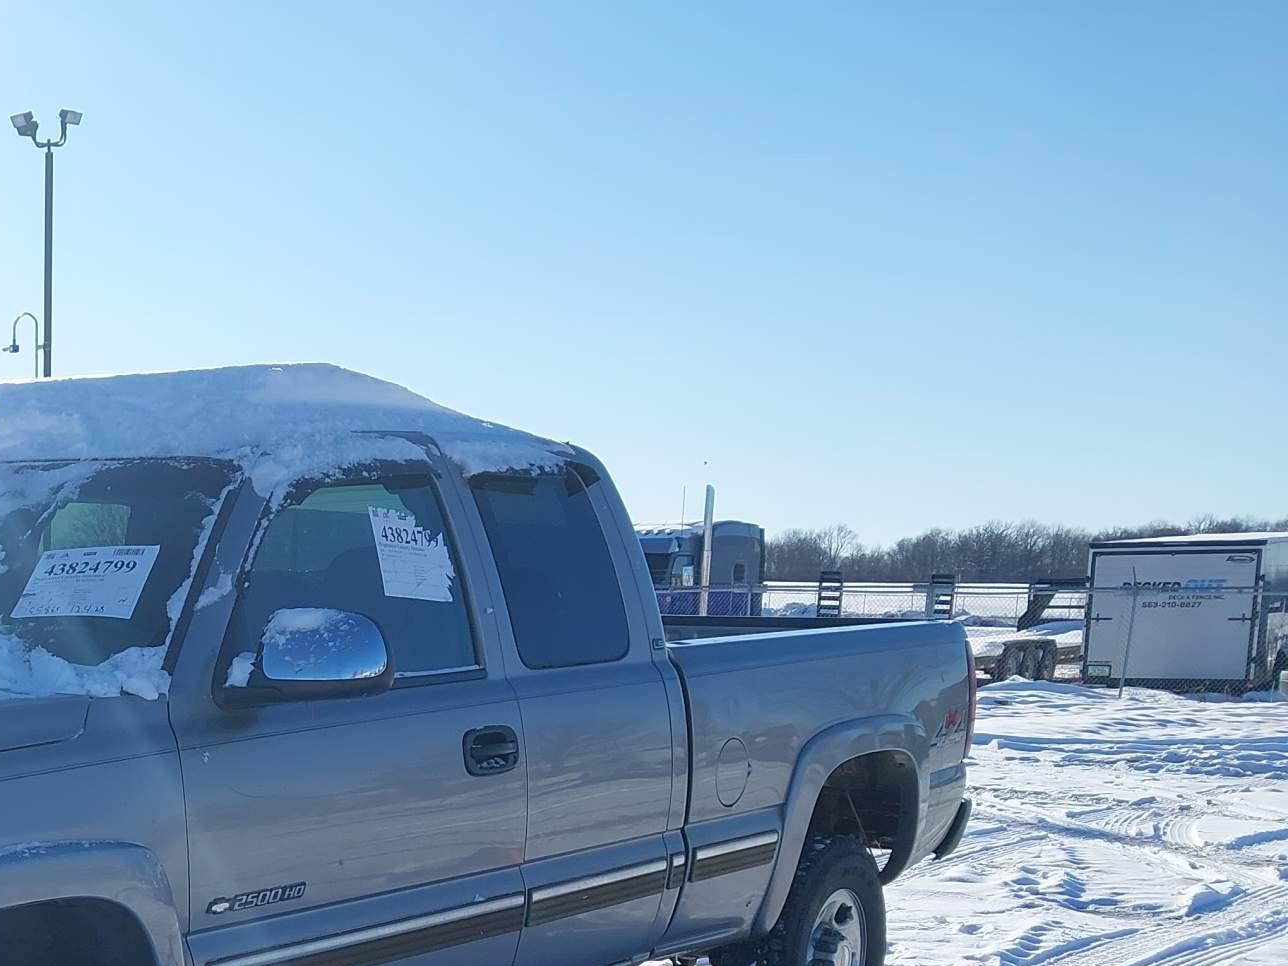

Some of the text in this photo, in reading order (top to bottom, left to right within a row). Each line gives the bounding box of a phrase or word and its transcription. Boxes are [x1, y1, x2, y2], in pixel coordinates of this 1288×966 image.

[44, 559, 138, 576] 43824799
[233, 884, 305, 911] 2500 HD
